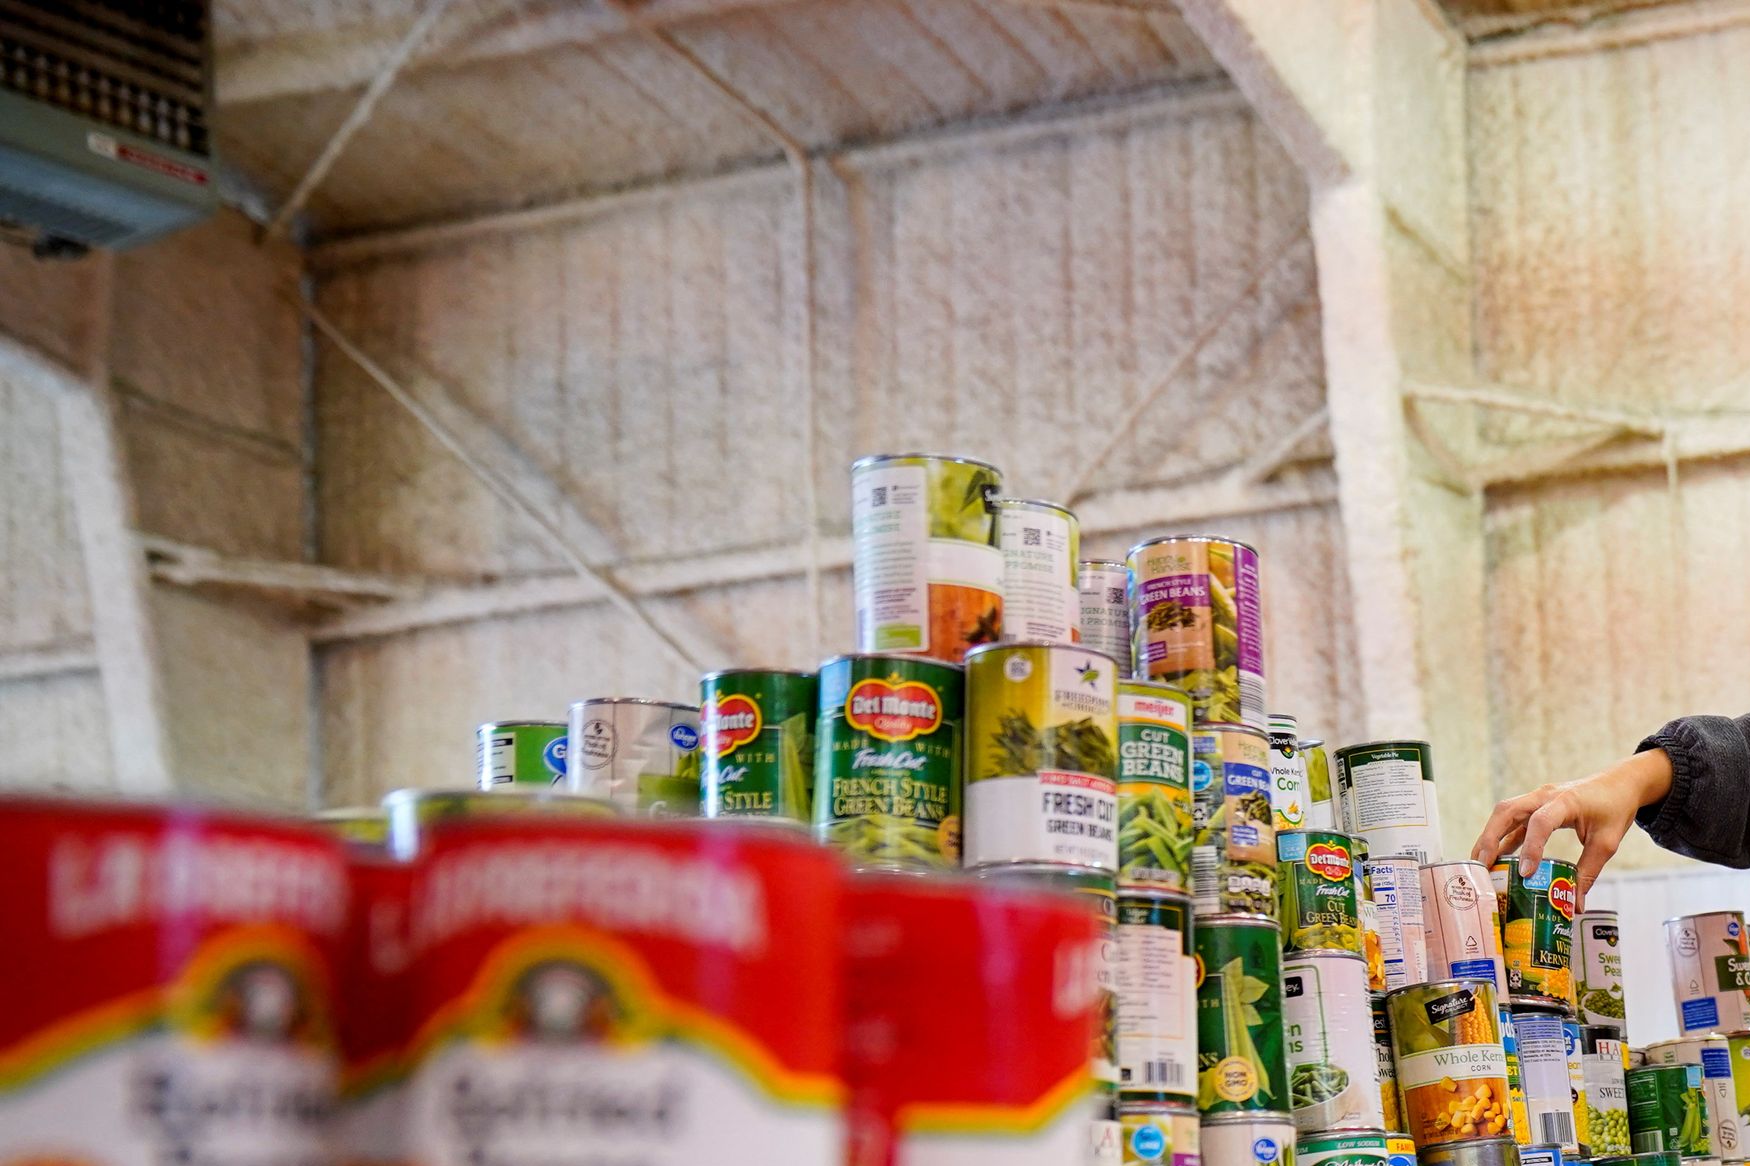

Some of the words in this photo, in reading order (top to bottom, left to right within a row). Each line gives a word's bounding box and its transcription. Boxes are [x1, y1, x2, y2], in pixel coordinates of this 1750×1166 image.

[1169, 584, 1206, 599] BEANS
[852, 696, 880, 715] Del
[883, 699, 937, 720] Monte
[1134, 701, 1175, 717] meijer
[1141, 728, 1170, 744] CUT
[1120, 741, 1185, 769] GREEN
[1122, 759, 1186, 784] BEANS
[832, 777, 897, 799] FRENCH
[899, 779, 949, 804] STYLE
[725, 791, 773, 810] STYLE
[1042, 792, 1095, 817] FRESH
[833, 798, 890, 817] GREEN
[893, 799, 946, 821] BEANS
[1046, 820, 1085, 840] GREEN
[1310, 852, 1327, 865] Del
[1371, 865, 1393, 875] Facts
[1385, 893, 1396, 903] 70
[1553, 887, 1567, 900] Del
[1327, 901, 1346, 913] CUT
[1305, 911, 1339, 924] GREEN
[1537, 912, 1563, 923] MADE
[1598, 953, 1621, 964] Swee
[1431, 996, 1469, 1016] Signature
[1434, 1051, 1479, 1067] Whole
[1470, 1064, 1492, 1073] CORN
